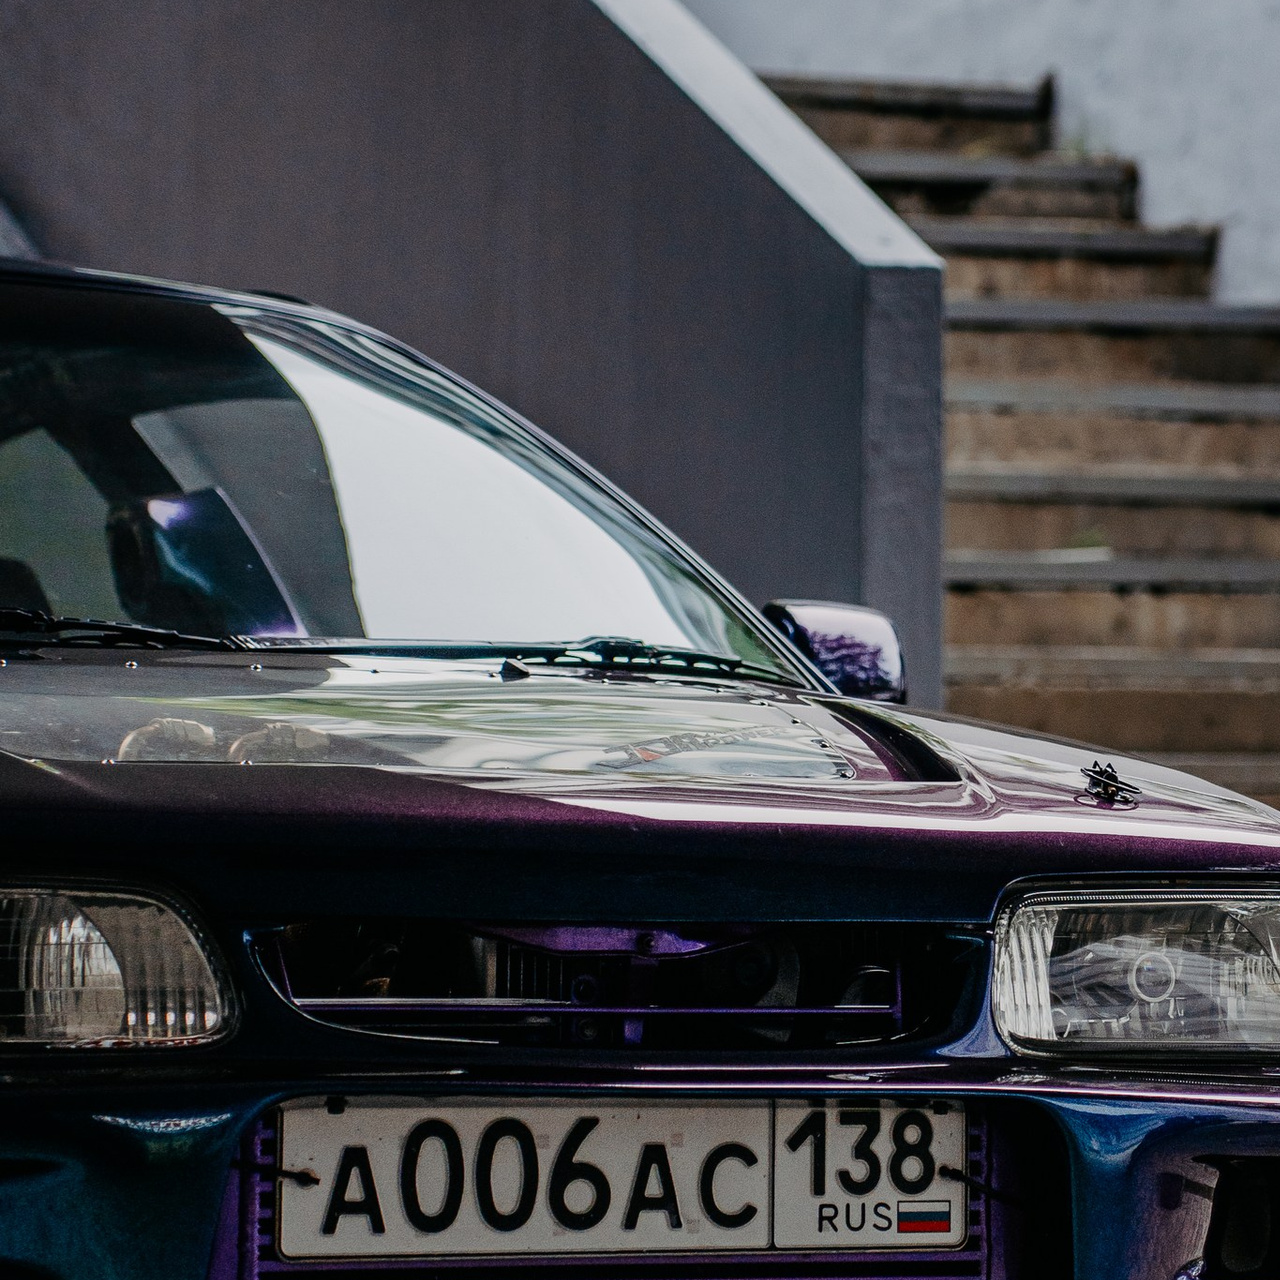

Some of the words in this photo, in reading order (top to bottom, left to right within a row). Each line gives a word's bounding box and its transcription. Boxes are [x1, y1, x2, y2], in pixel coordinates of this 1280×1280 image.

[321, 1117, 760, 1235] A006AC
[784, 1110, 936, 1196] 138
[817, 1201, 893, 1234] RUS
